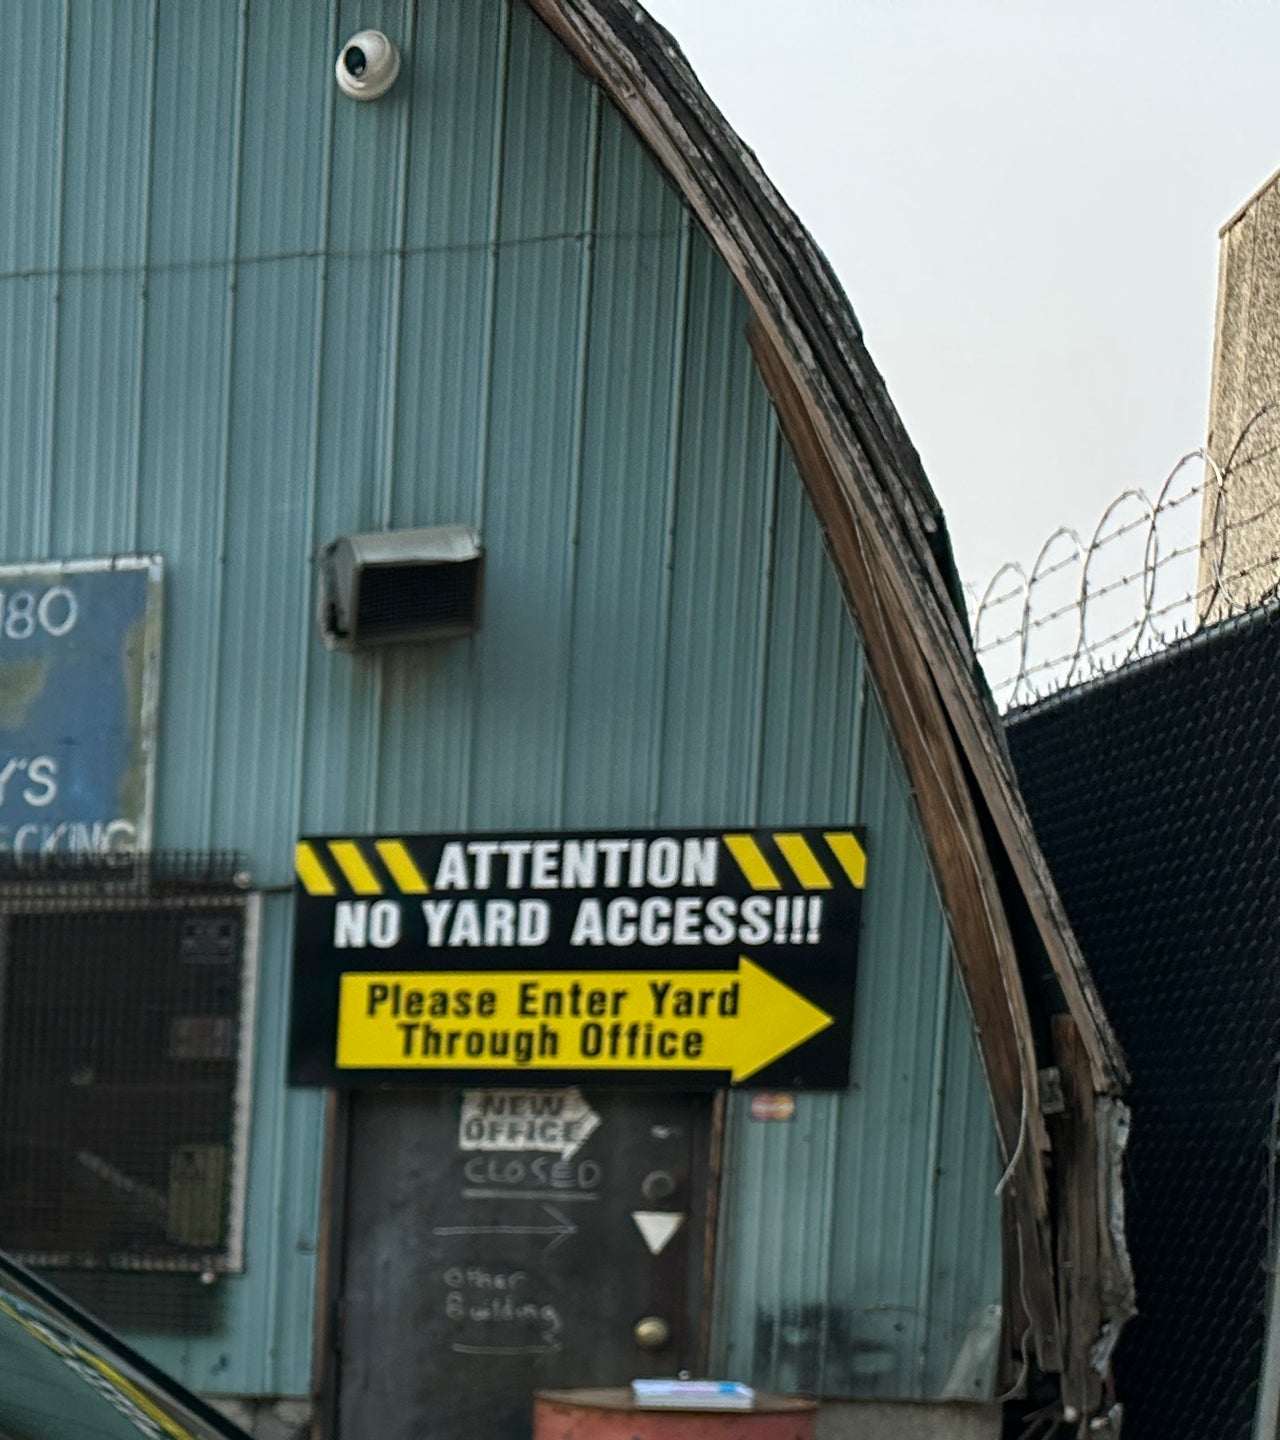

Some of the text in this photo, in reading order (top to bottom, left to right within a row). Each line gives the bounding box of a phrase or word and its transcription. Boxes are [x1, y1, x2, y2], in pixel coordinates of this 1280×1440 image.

[435, 836, 719, 892] ATTENTION
[334, 895, 824, 948] NO YARD ACCESS!!!
[366, 981, 741, 1018] Please Enter Yard
[397, 1023, 704, 1065] Through Office
[479, 1094, 566, 1117] NEW
[465, 1117, 579, 1143] OFFICE
[464, 1156, 602, 1190] CLOSED
